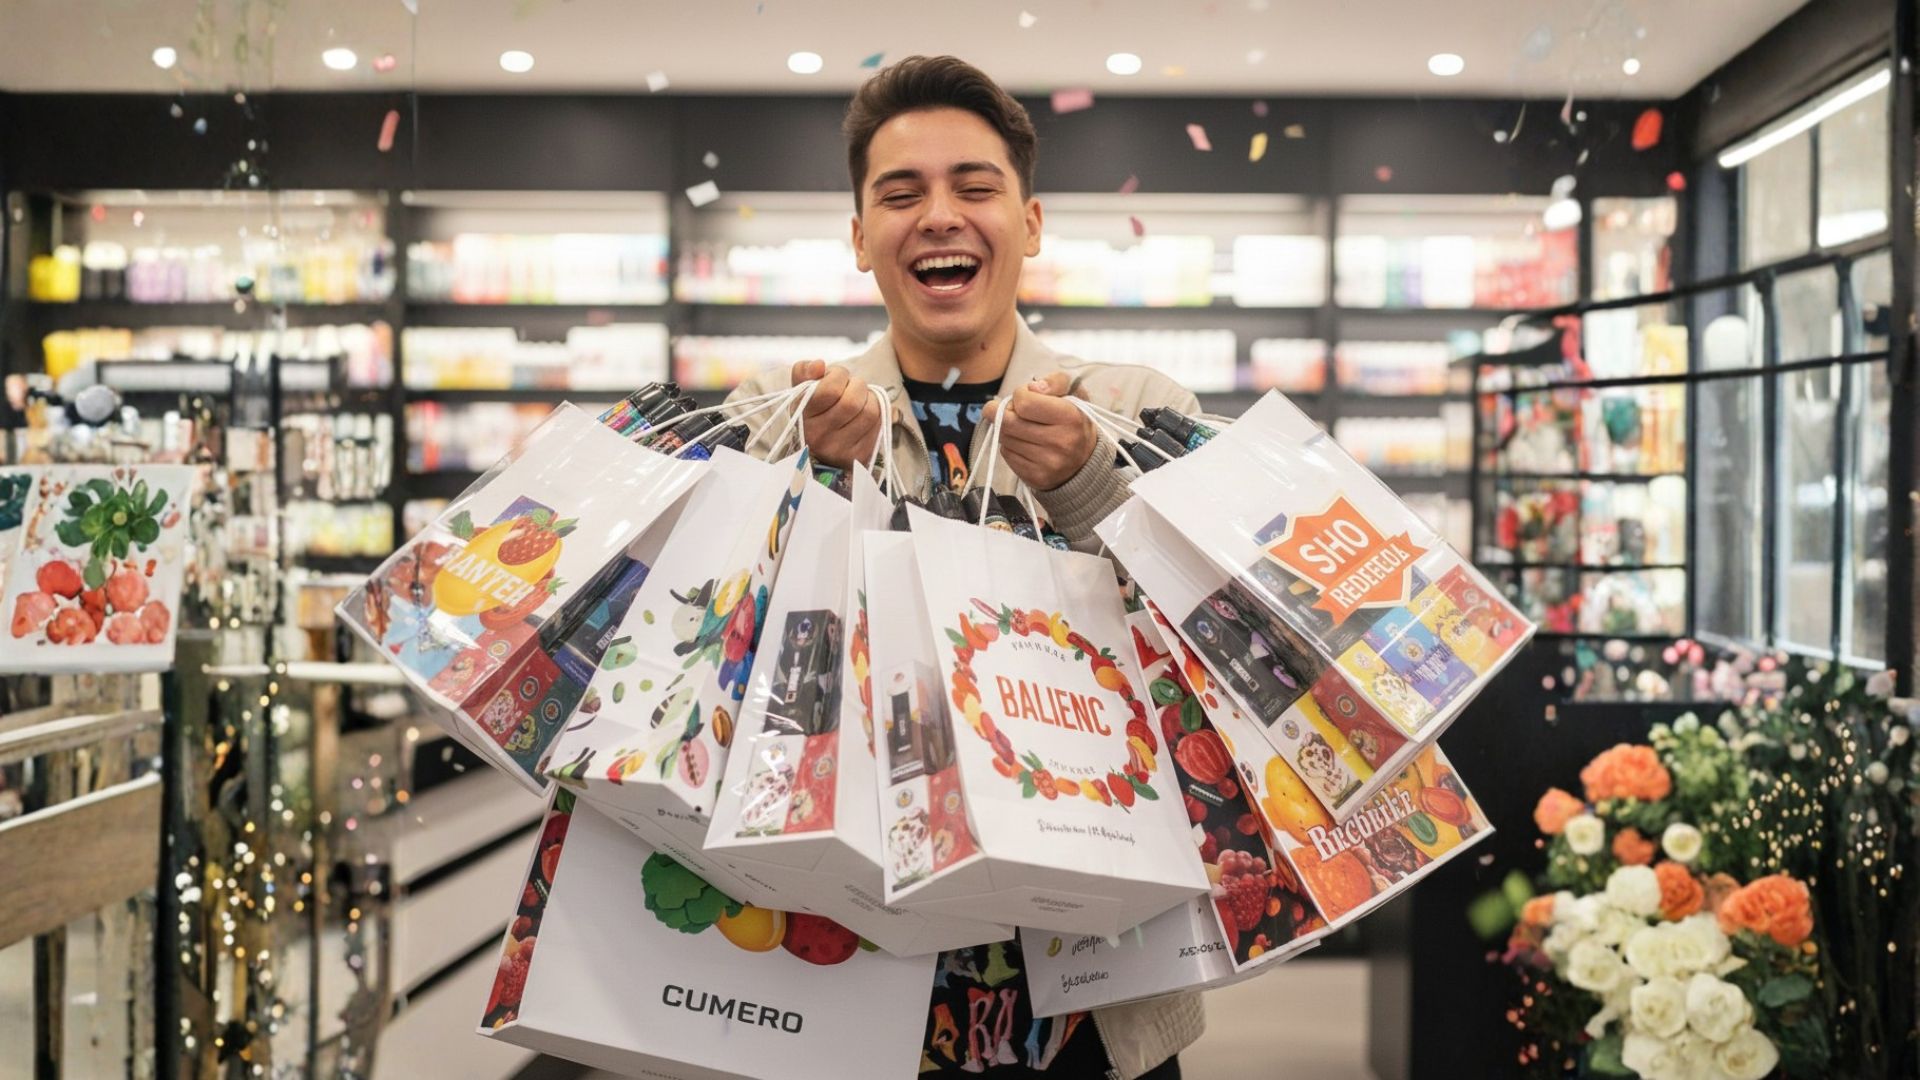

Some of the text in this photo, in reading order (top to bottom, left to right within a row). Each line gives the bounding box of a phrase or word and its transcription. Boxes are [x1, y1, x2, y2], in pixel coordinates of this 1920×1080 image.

[1299, 519, 1369, 574] SHO
[996, 675, 1112, 737] BALIENC
[662, 984, 803, 1034] CUMERO
